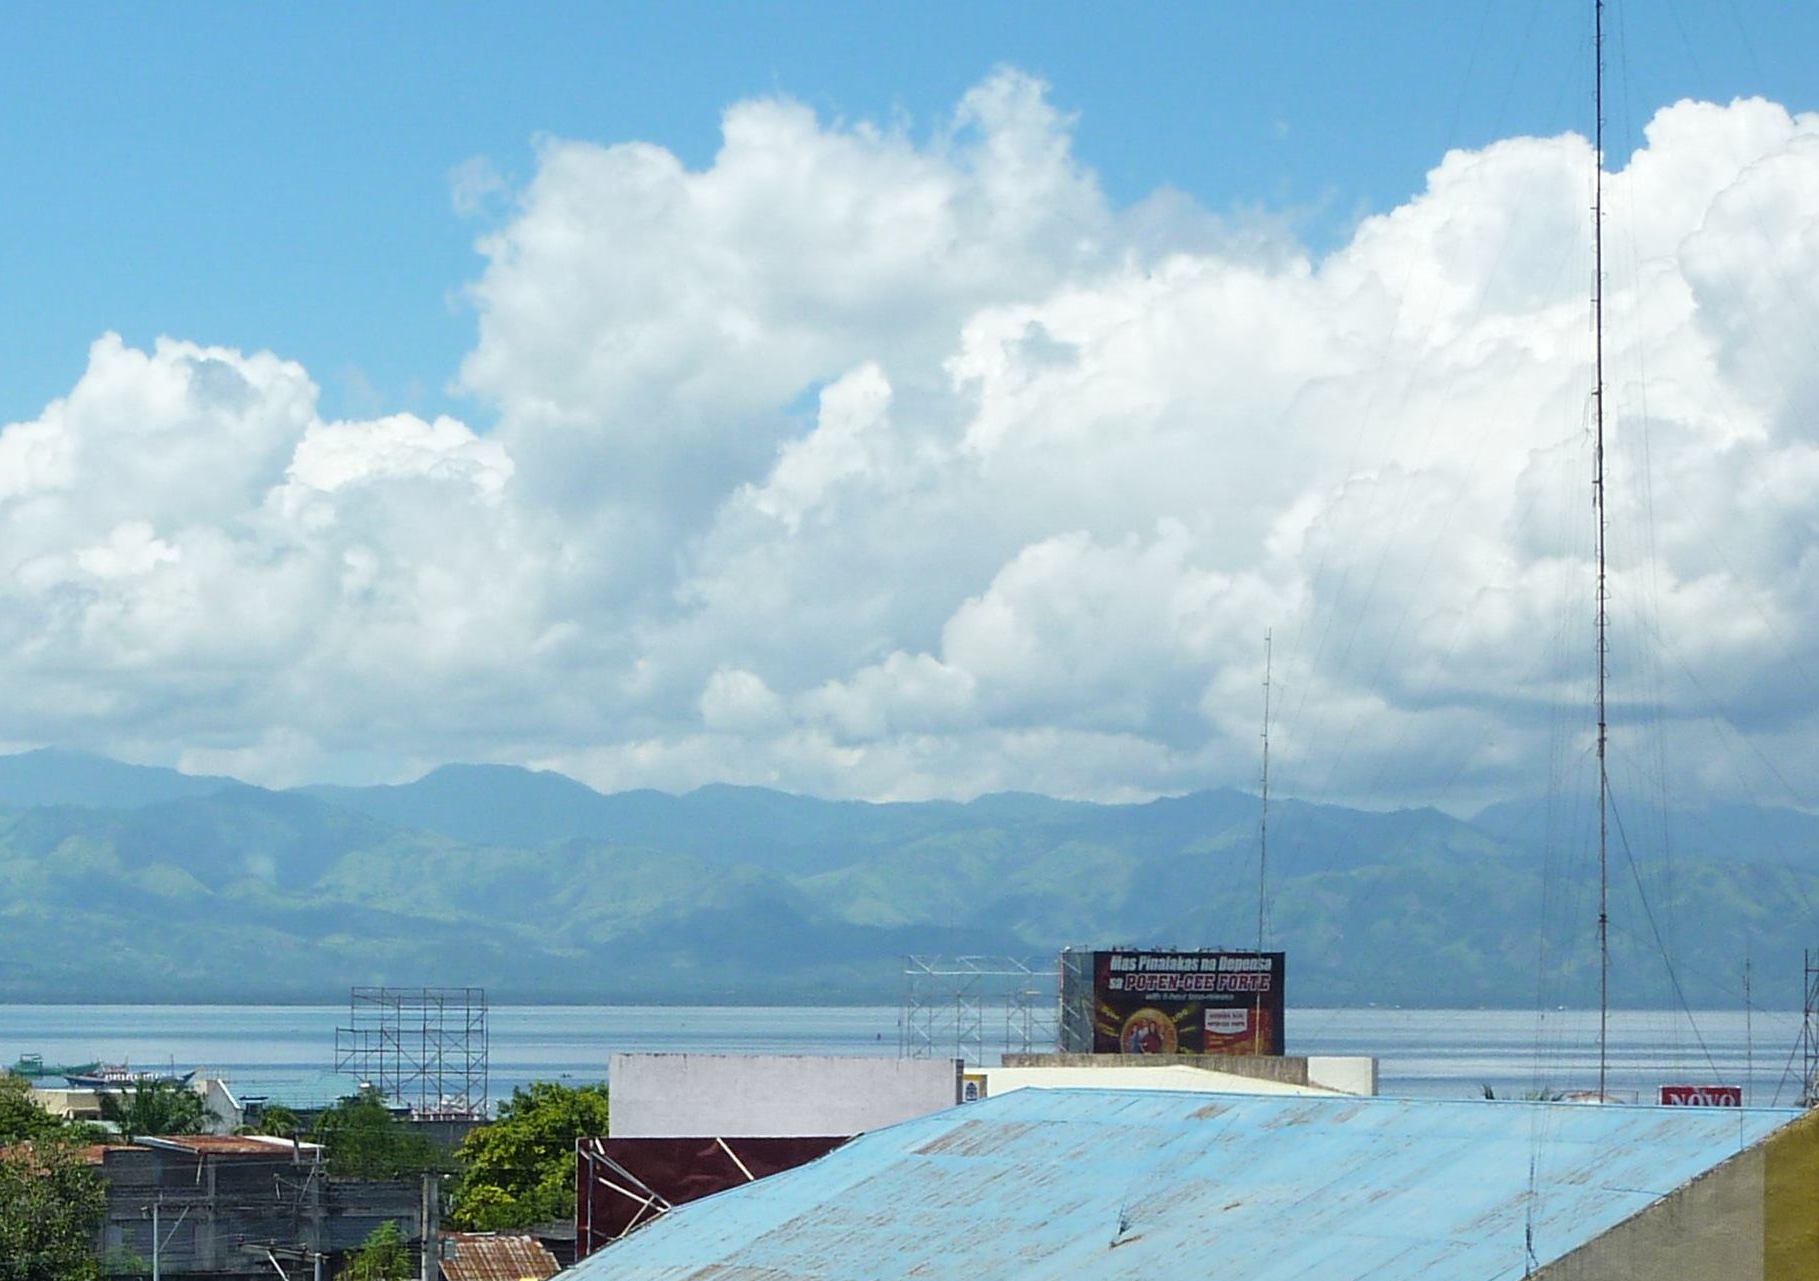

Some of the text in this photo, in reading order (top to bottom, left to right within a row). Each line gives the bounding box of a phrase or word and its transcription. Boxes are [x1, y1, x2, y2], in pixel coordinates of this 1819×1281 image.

[1110, 955, 1272, 973] Mas Pinalakas na Depensa
[1108, 973, 1272, 992] sa POTEN-CEE FORTE
